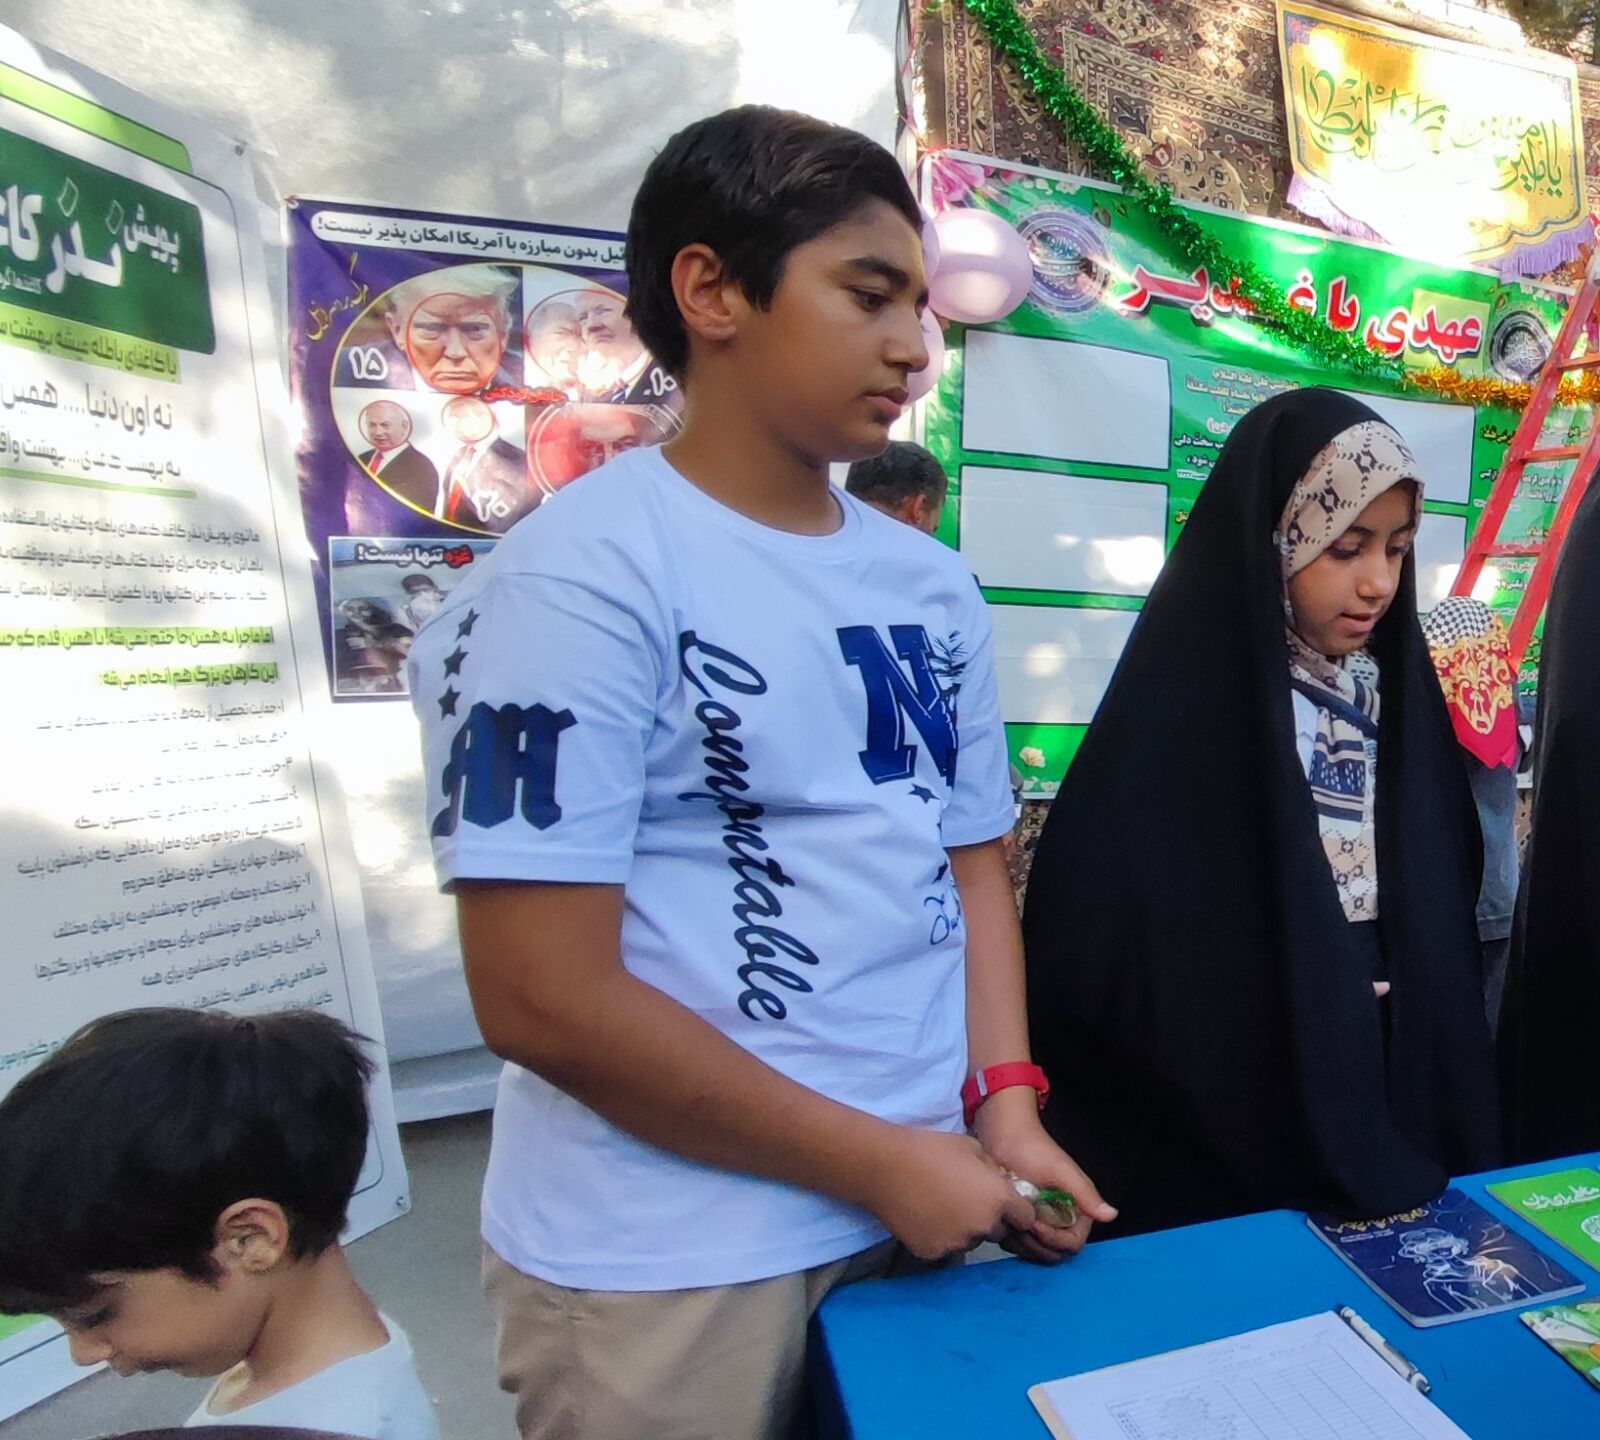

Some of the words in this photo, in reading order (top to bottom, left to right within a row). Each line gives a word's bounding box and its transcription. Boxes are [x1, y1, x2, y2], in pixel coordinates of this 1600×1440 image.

[0, 184, 43, 262] کا
[374, 222, 408, 246] پذیر
[124, 203, 179, 273] پویش
[410, 227, 454, 246] امکان
[457, 229, 504, 252] آمریکا
[505, 236, 517, 252] با
[520, 238, 561, 258] مبارزه
[563, 244, 598, 261] بدون
[9, 317, 53, 350] بهشت
[1364, 304, 1483, 365] عهدی
[121, 394, 150, 436] اون
[154, 402, 173, 430] نه
[23, 439, 66, 469] بهشت
[358, 545, 413, 566] نیست!
[414, 547, 445, 567] تنها
